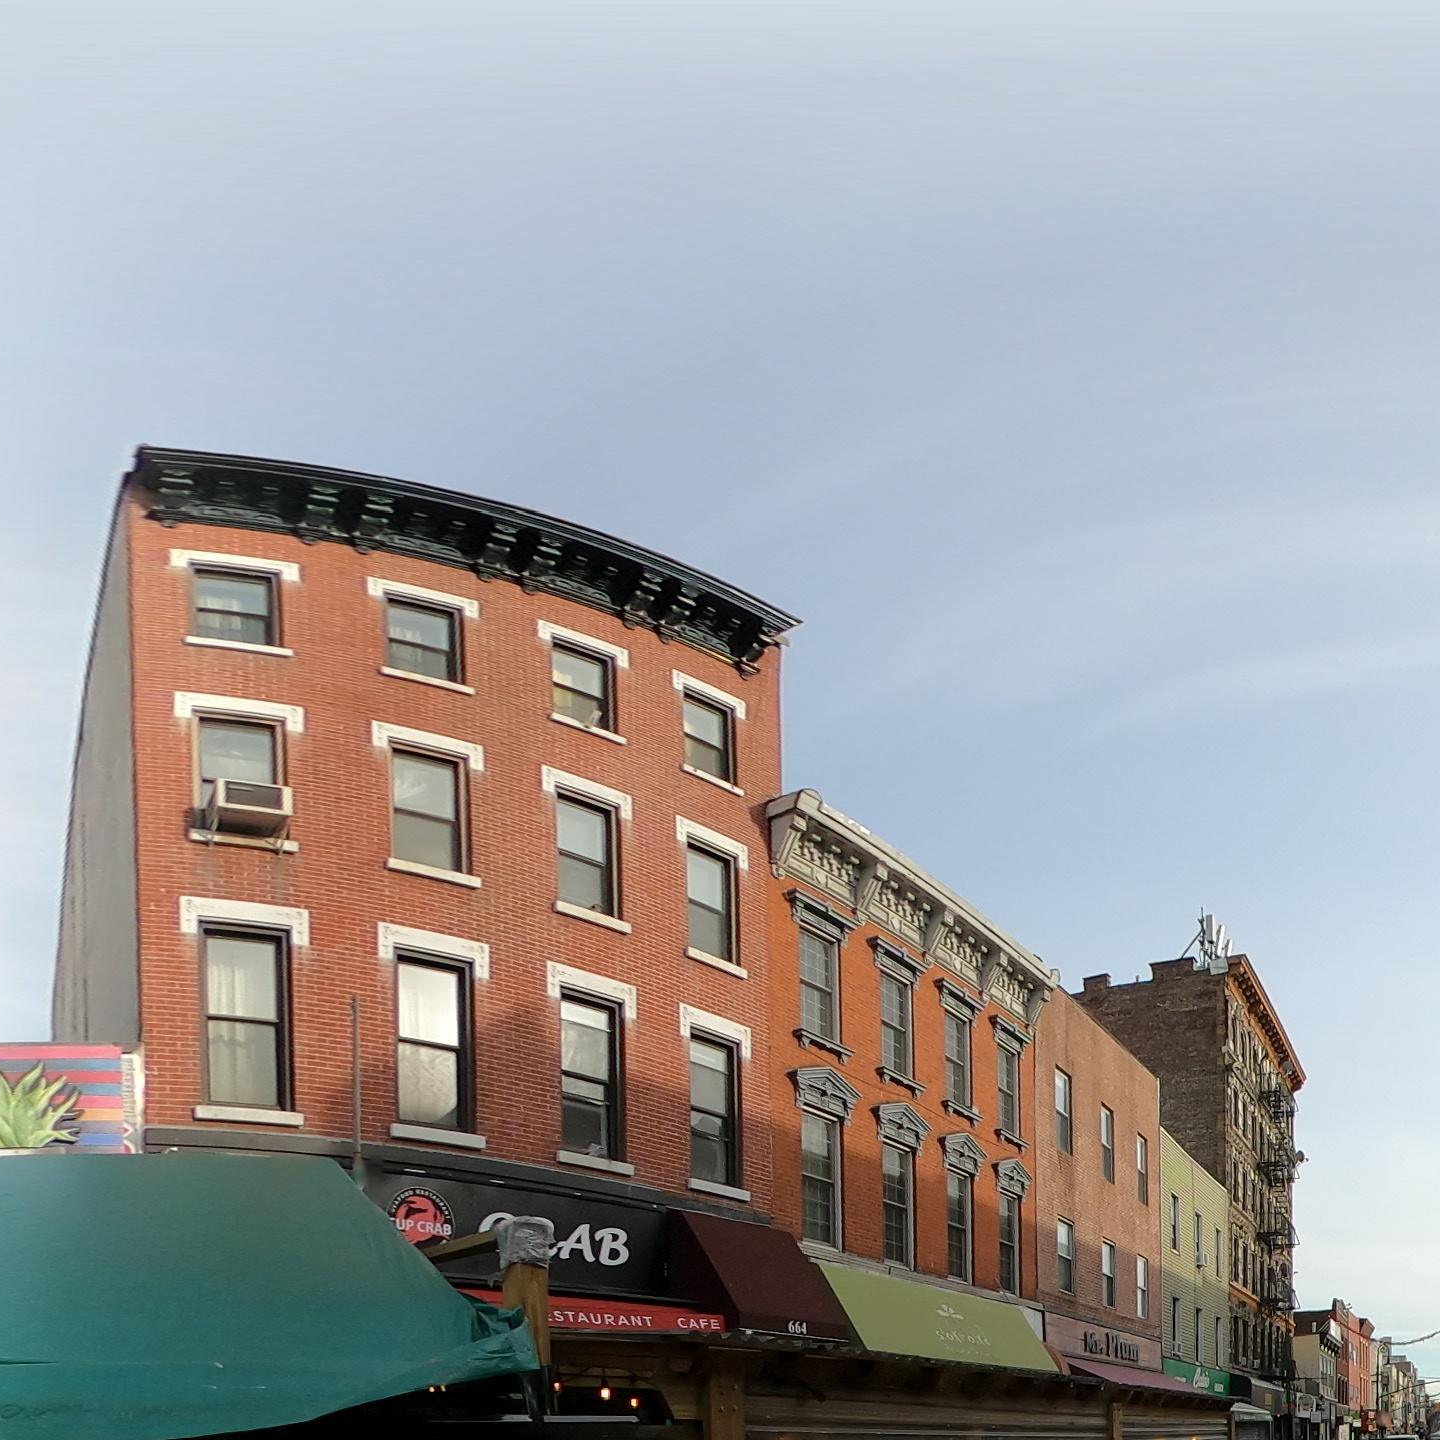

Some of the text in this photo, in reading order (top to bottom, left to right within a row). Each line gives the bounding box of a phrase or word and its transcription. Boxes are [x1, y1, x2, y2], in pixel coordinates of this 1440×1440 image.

[389, 1217, 453, 1236] UP CRAB
[478, 1212, 630, 1266] CAB
[548, 1310, 722, 1330] STAURANT CAFE
[788, 1319, 808, 1336] 664
[1106, 1330, 1141, 1363] Plum
